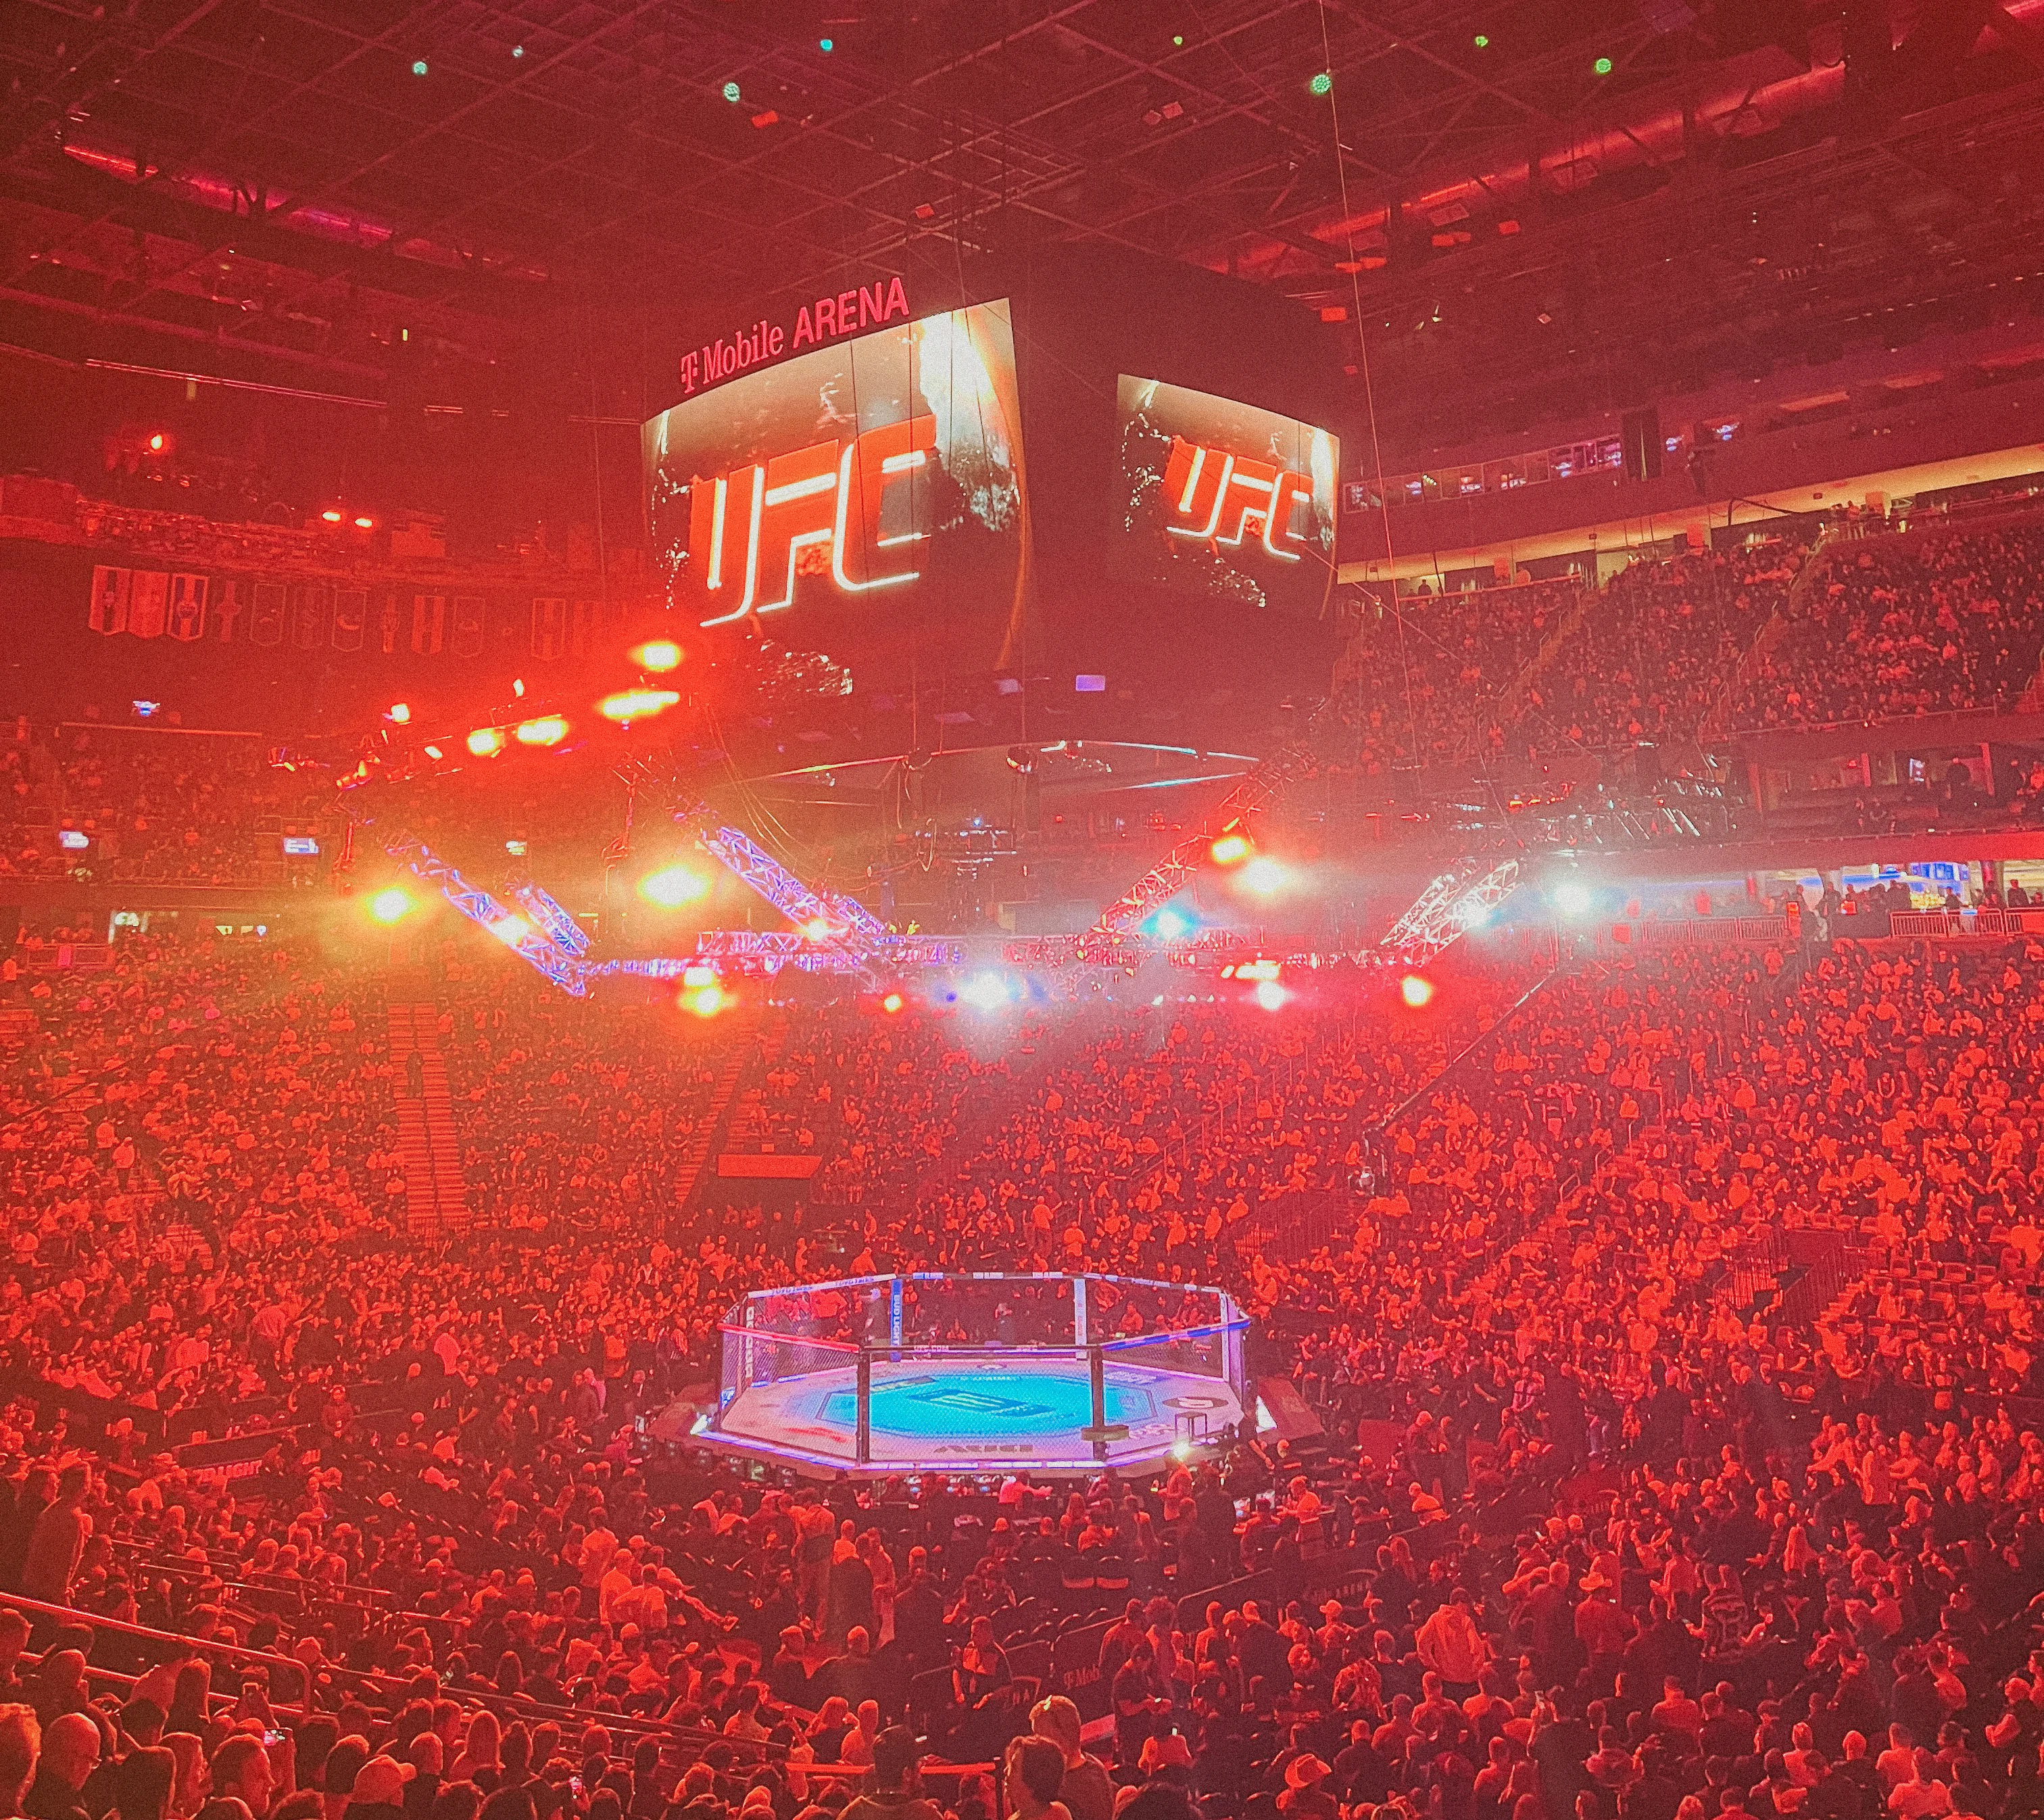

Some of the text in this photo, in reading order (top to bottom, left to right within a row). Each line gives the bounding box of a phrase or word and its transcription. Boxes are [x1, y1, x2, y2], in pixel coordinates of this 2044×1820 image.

[702, 320, 784, 385] Mobile
[792, 277, 910, 349] ARENA
[689, 414, 936, 627] UFC
[1162, 438, 1314, 560] UFC
